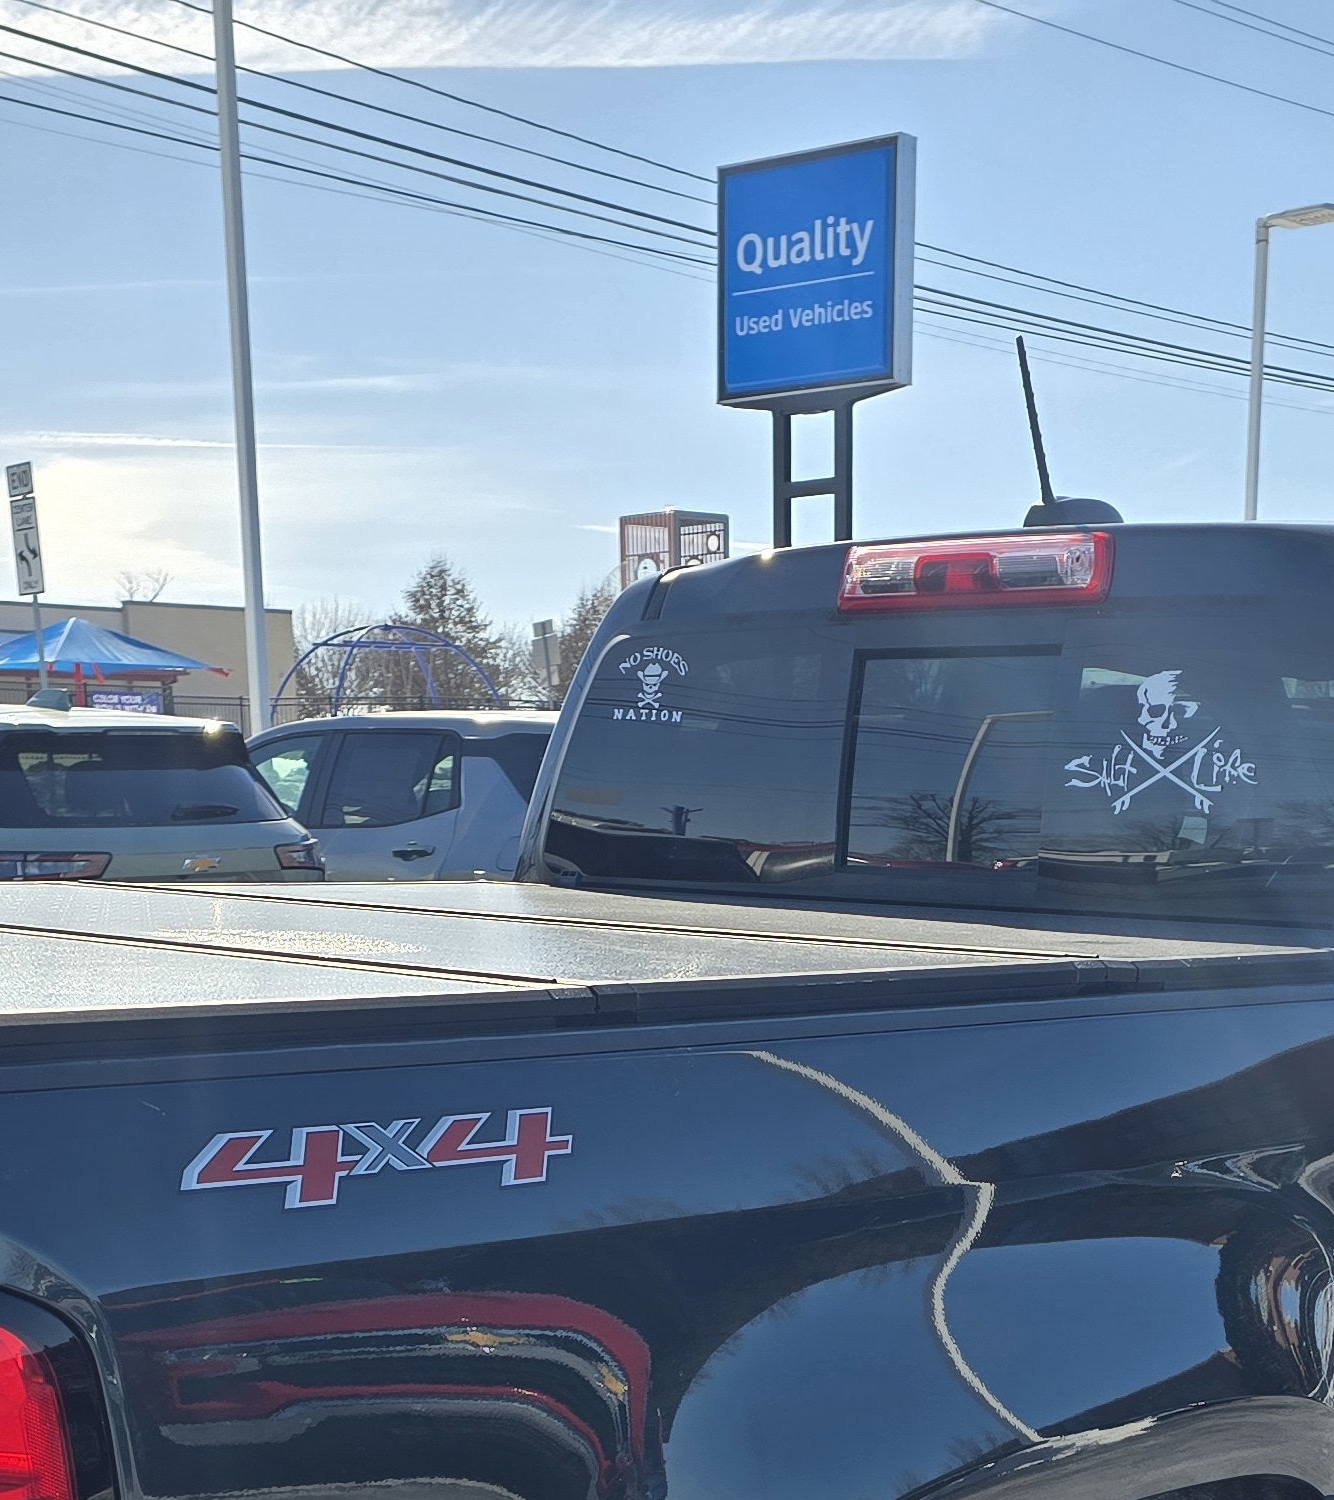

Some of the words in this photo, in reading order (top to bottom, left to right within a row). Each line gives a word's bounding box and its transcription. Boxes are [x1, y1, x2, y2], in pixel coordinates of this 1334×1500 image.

[736, 216, 875, 274] Quality
[735, 309, 783, 336] Used
[789, 299, 873, 328] Vehicles
[10, 470, 30, 490] END
[619, 652, 641, 675] NO
[643, 647, 689, 676] SHOES
[613, 708, 683, 722] NATION
